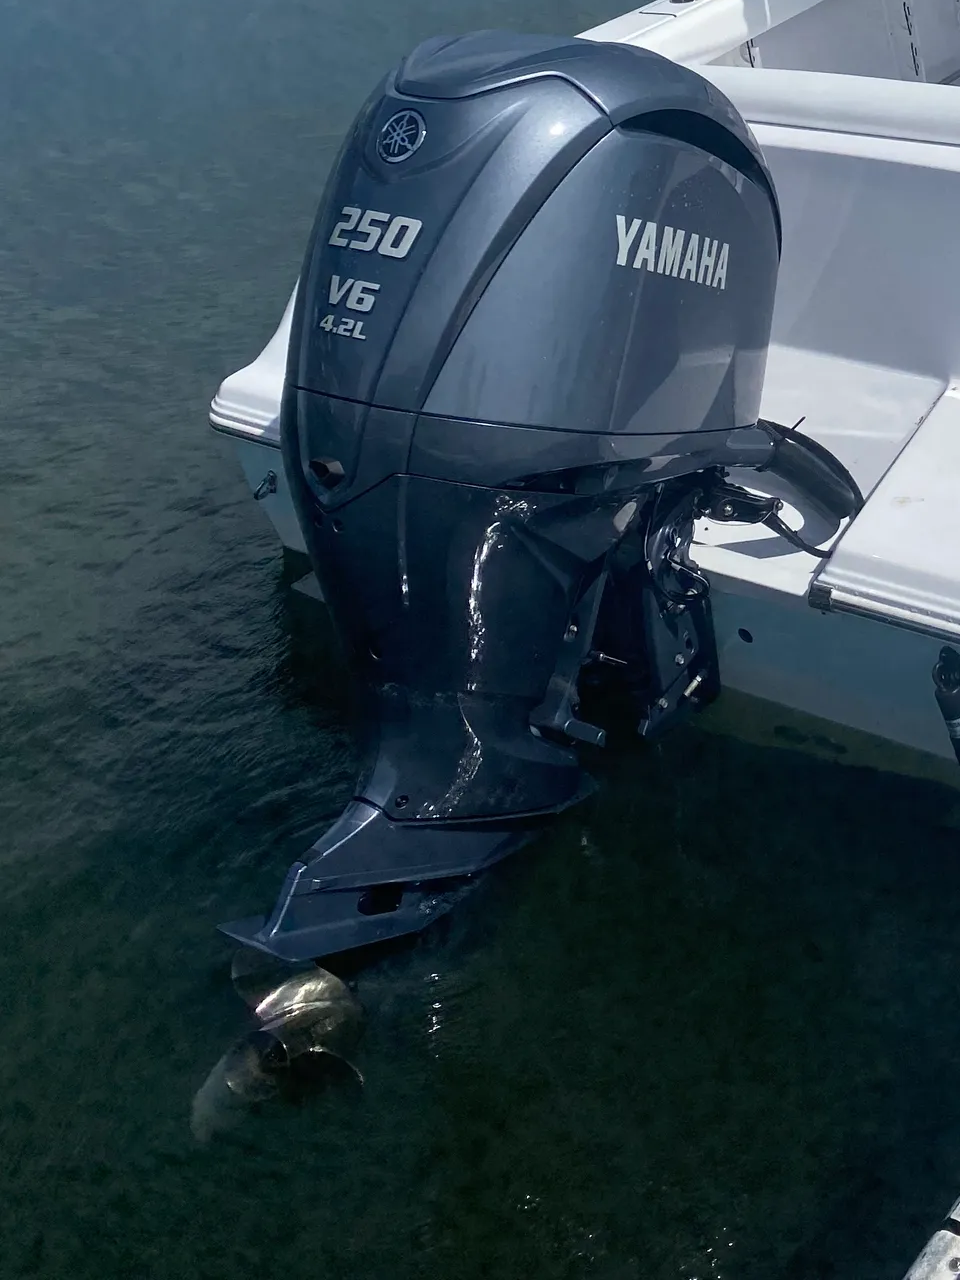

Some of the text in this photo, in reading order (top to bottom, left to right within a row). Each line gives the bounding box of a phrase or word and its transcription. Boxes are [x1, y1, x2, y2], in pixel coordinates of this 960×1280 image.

[328, 206, 423, 259] 250
[616, 214, 730, 290] YAMAHA
[328, 274, 381, 312] V6
[319, 314, 367, 340] 4.2L
